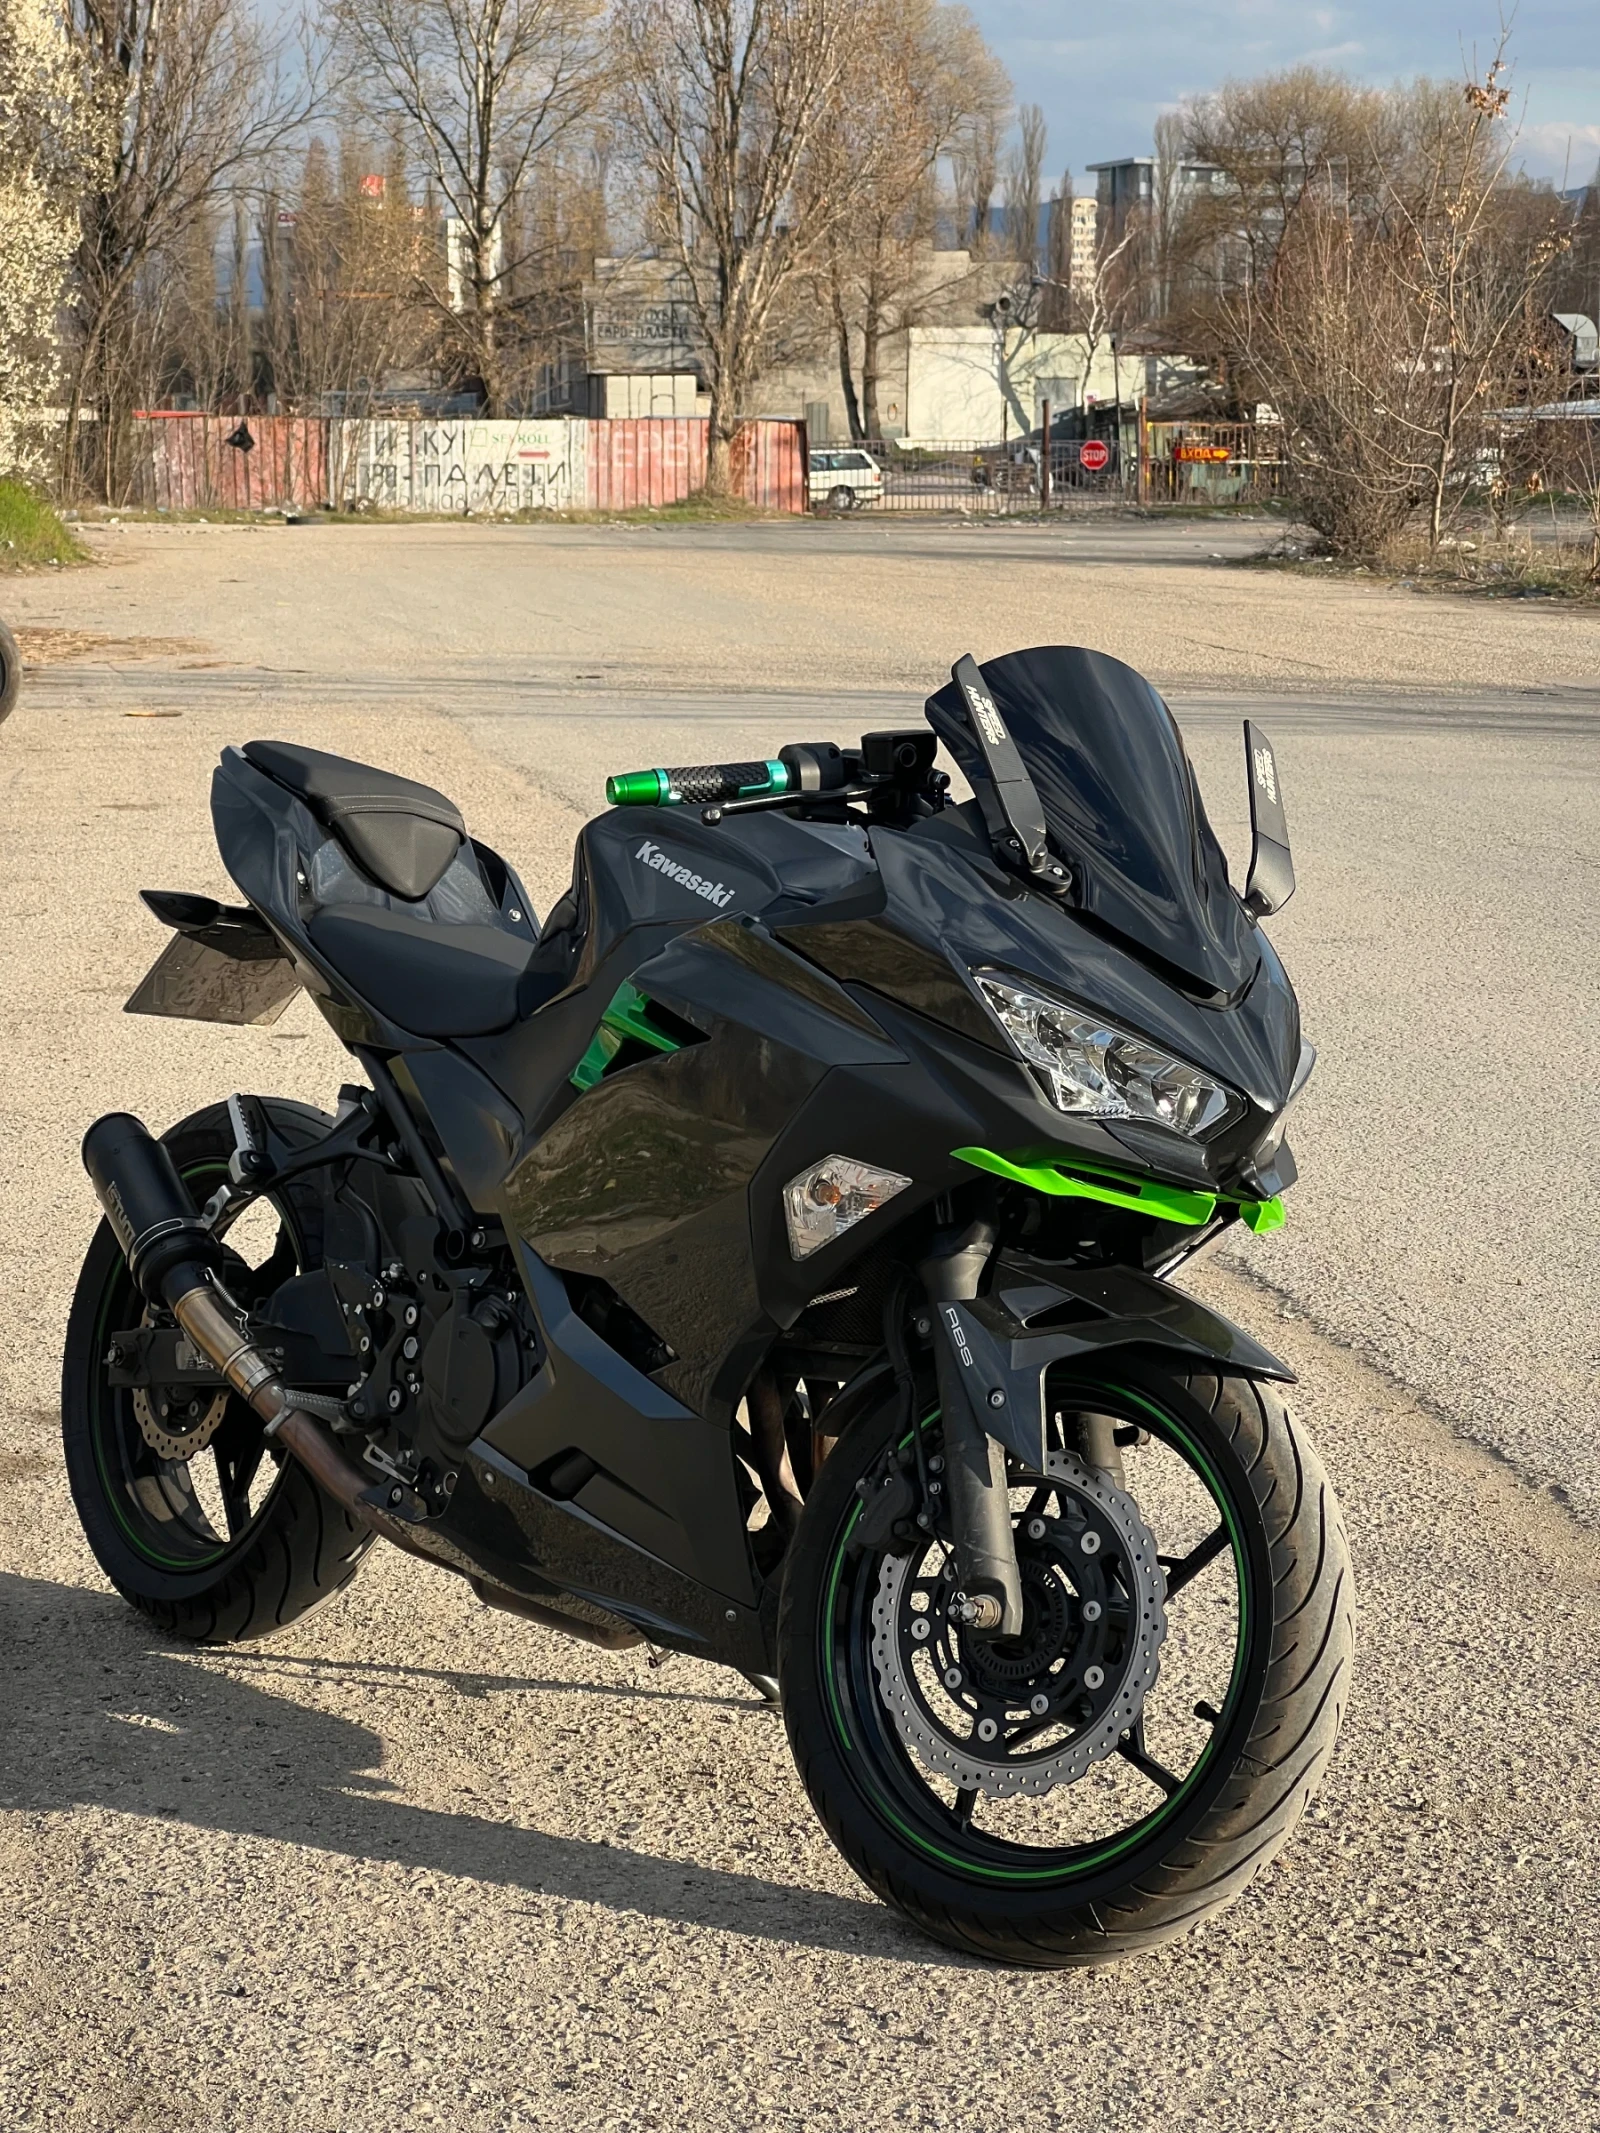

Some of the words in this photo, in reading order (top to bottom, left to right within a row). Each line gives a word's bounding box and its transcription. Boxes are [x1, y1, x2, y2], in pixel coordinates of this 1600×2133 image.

[1083, 449, 1106, 461] STOP
[965, 684, 1000, 746] HUNTERS
[981, 697, 1006, 739] SPEED
[1254, 748, 1267, 789] SPEED
[634, 840, 736, 909] Kawasaki
[945, 1307, 973, 1367] ABS
